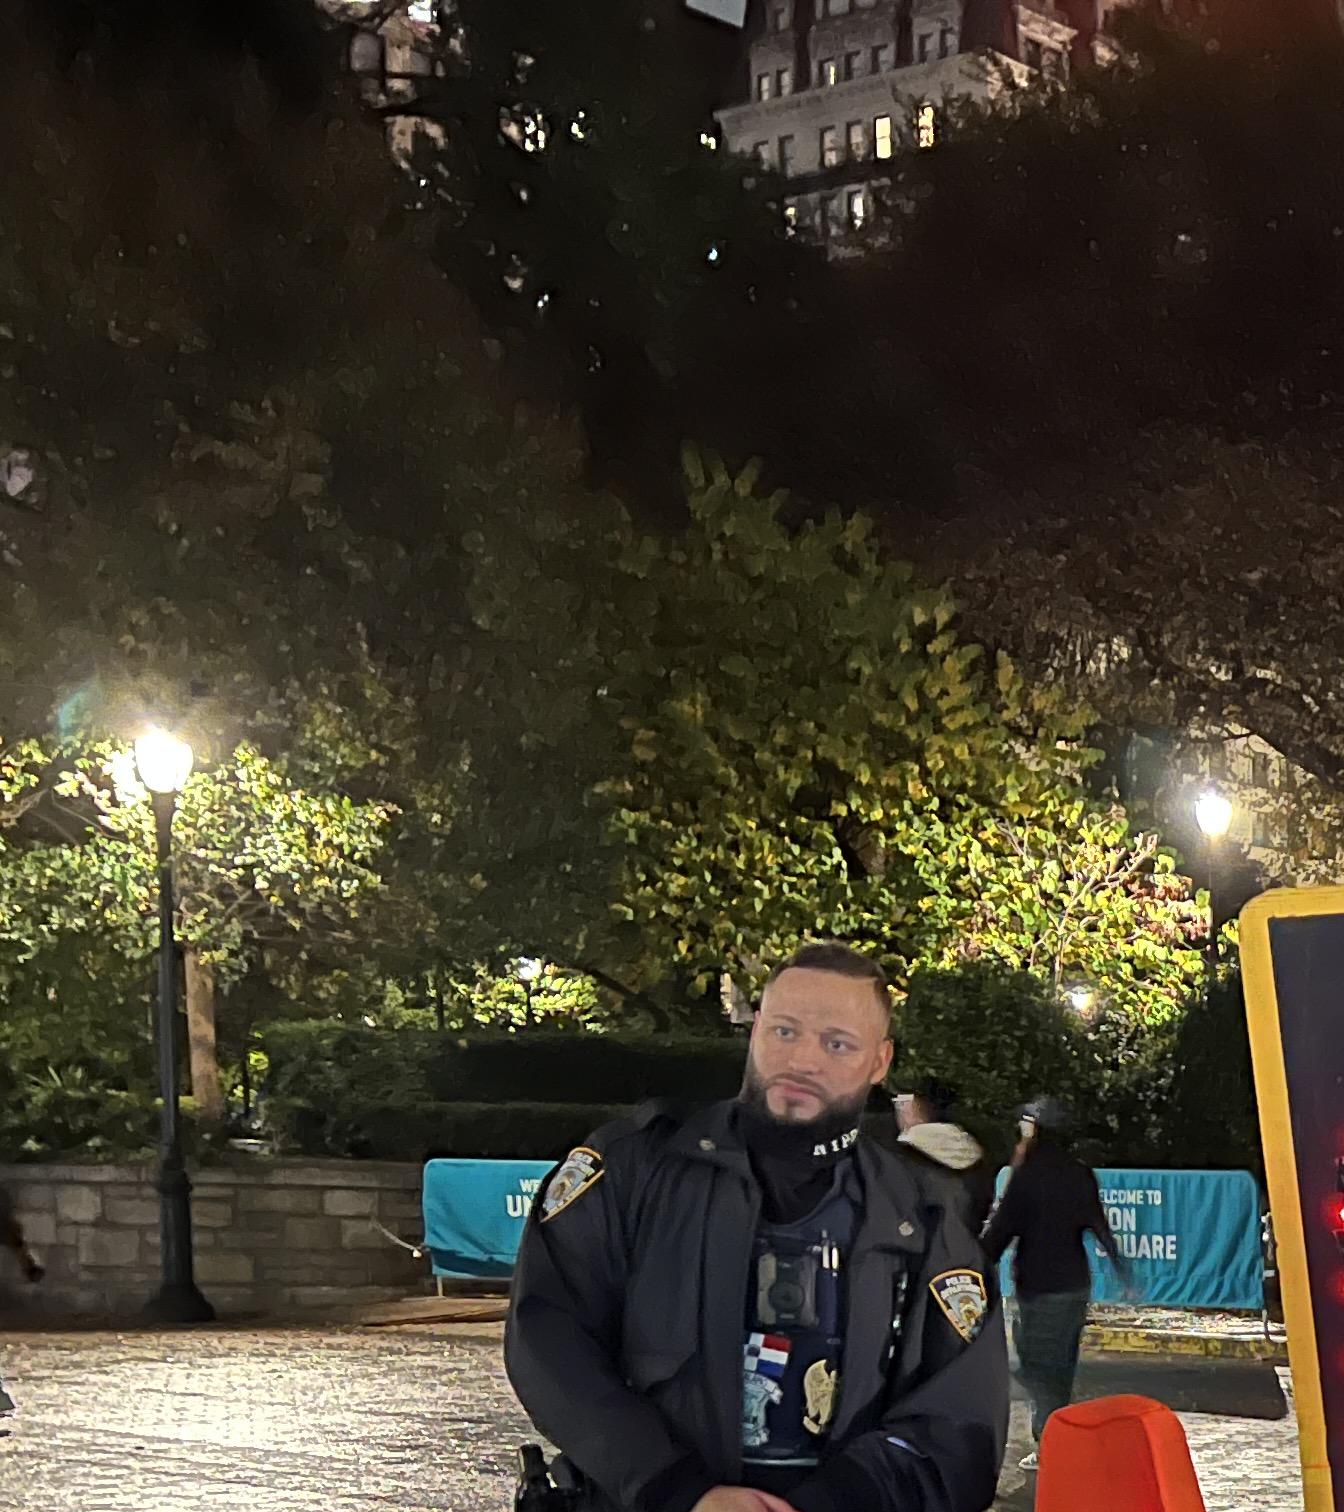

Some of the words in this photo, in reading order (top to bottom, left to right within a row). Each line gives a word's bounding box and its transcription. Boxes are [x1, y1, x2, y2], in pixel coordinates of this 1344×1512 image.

[1098, 1189, 1145, 1205] ELCOME
[1146, 1190, 1162, 1206] TO
[1104, 1207, 1136, 1232] ON
